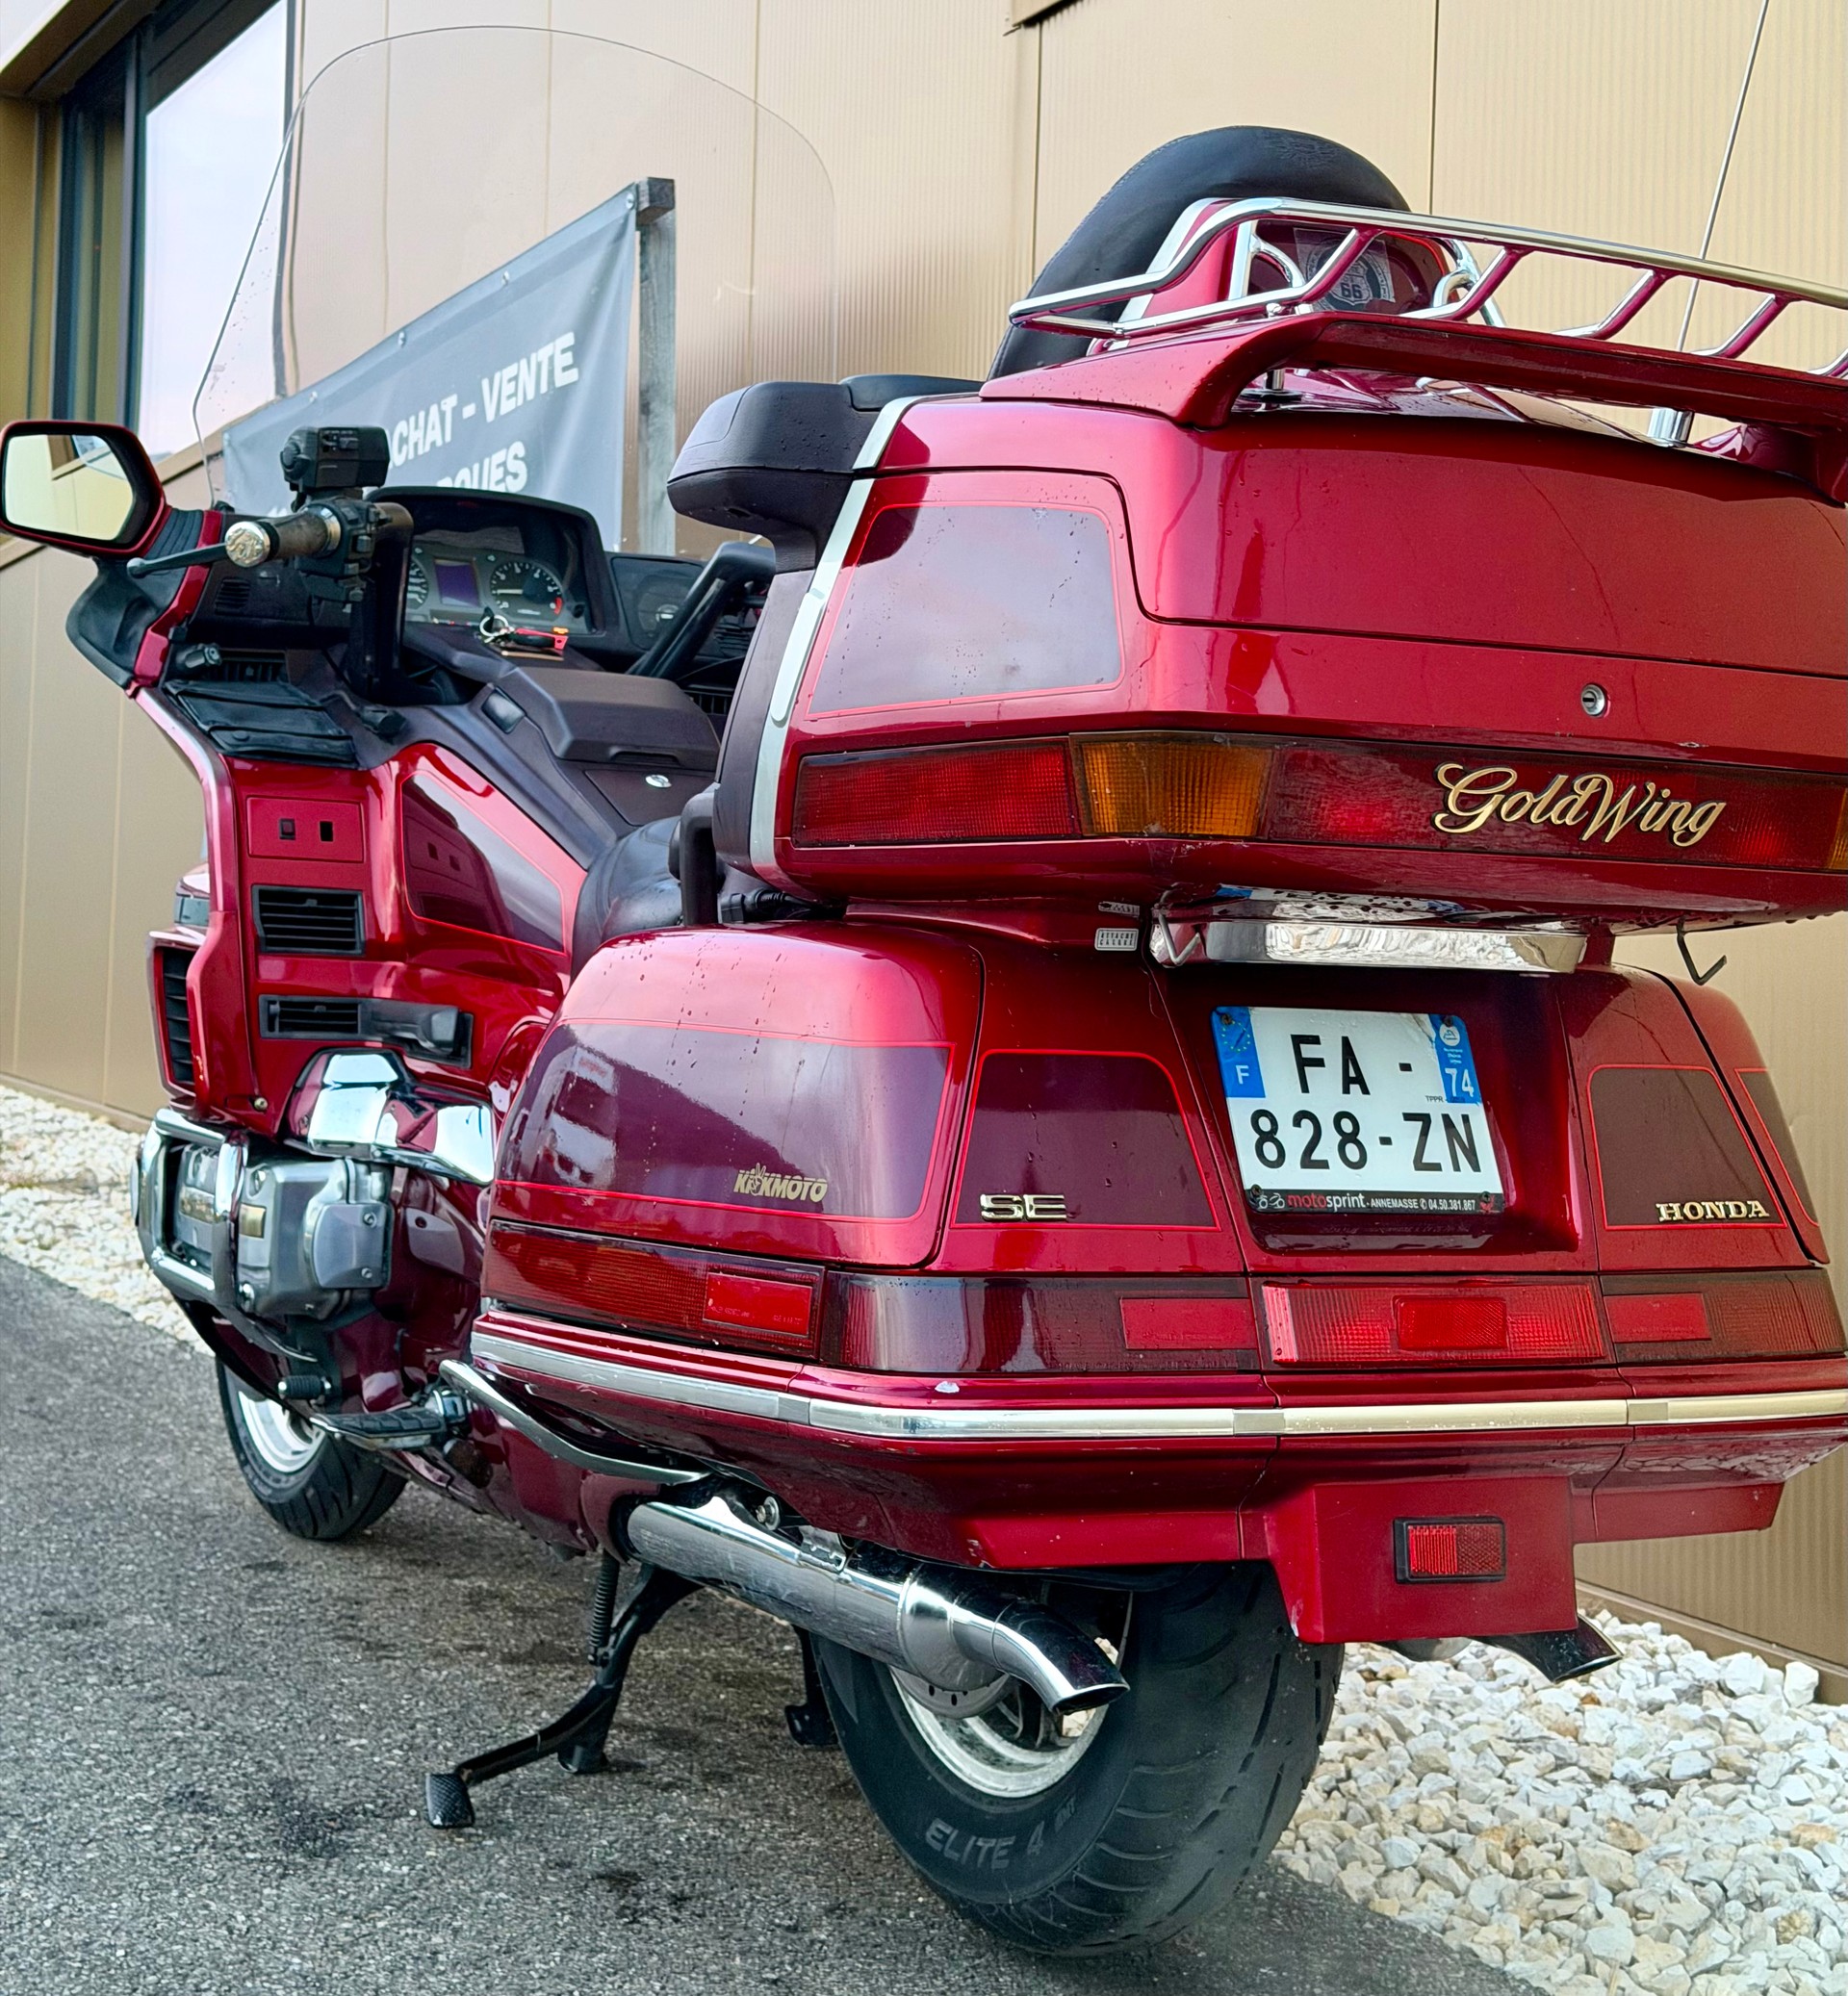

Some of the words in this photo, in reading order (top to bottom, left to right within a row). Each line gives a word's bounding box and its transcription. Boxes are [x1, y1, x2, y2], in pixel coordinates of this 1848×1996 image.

[1340, 283, 1363, 299] 66
[386, 393, 457, 470] CHAT
[481, 331, 578, 423] VENTE
[1236, 1064, 1249, 1086] F
[1445, 1067, 1475, 1098] 74
[1250, 1109, 1482, 1173] 828-ZN
[980, 1194, 1067, 1222] SE
[1287, 1193, 1366, 1213] motosprint
[1656, 1200, 1770, 1222] HONDA
[925, 1817, 1016, 1871] ELITE
